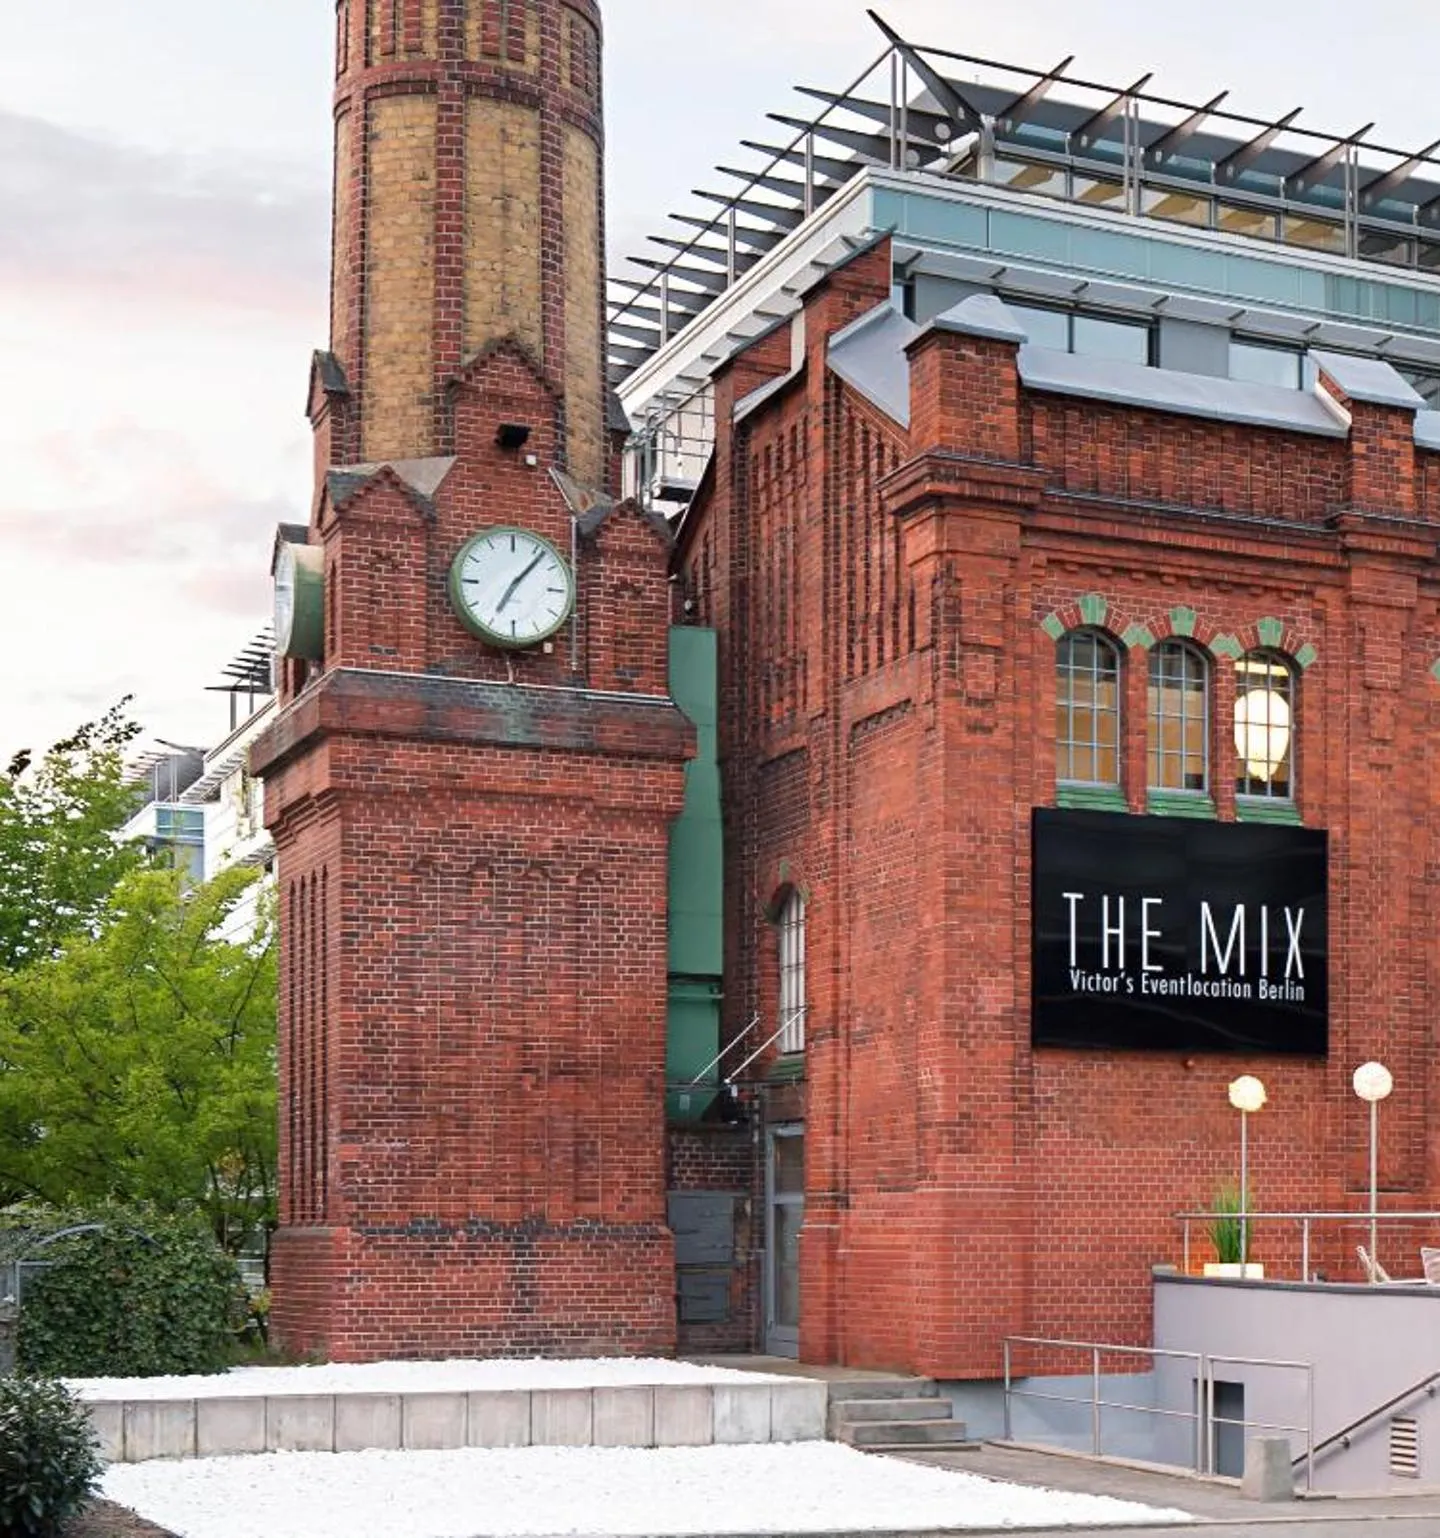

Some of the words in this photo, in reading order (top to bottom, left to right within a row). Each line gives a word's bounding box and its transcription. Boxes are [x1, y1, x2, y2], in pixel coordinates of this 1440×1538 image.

[1062, 892, 1164, 972] THE
[1200, 900, 1305, 979] MIX
[1069, 969, 1134, 993] Victor's
[1141, 972, 1251, 999] Eventlocation
[1259, 978, 1305, 1001] Berlin
